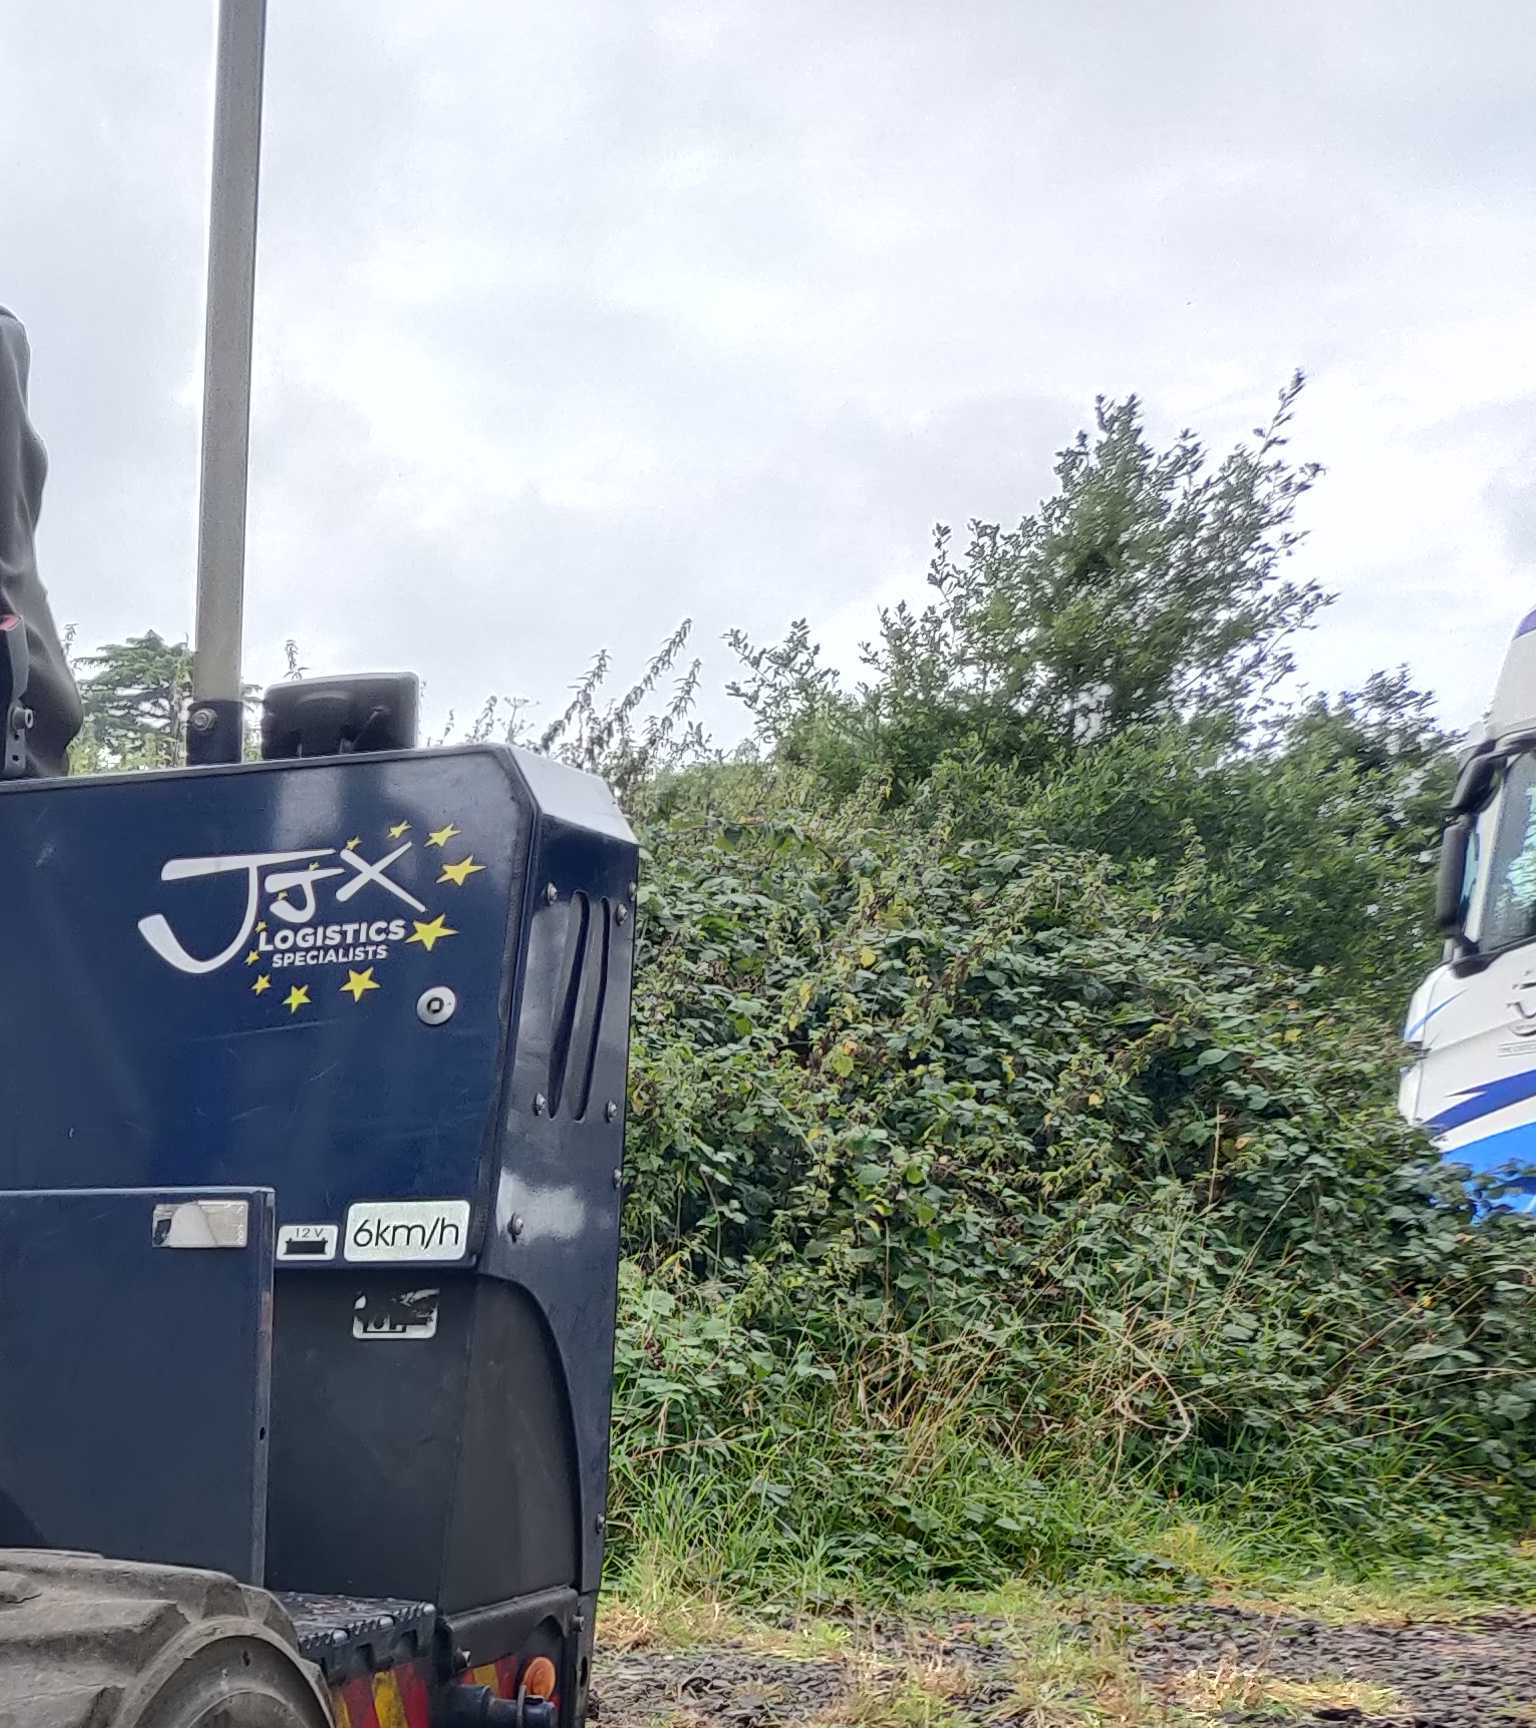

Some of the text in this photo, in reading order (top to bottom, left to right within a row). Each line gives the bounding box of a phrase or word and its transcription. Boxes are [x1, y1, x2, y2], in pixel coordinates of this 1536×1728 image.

[259, 919, 407, 951] LOGISTICS
[272, 944, 389, 968] SPECIALISTS
[295, 1227, 324, 1239] 12 V
[352, 1217, 460, 1250] 6km/h
